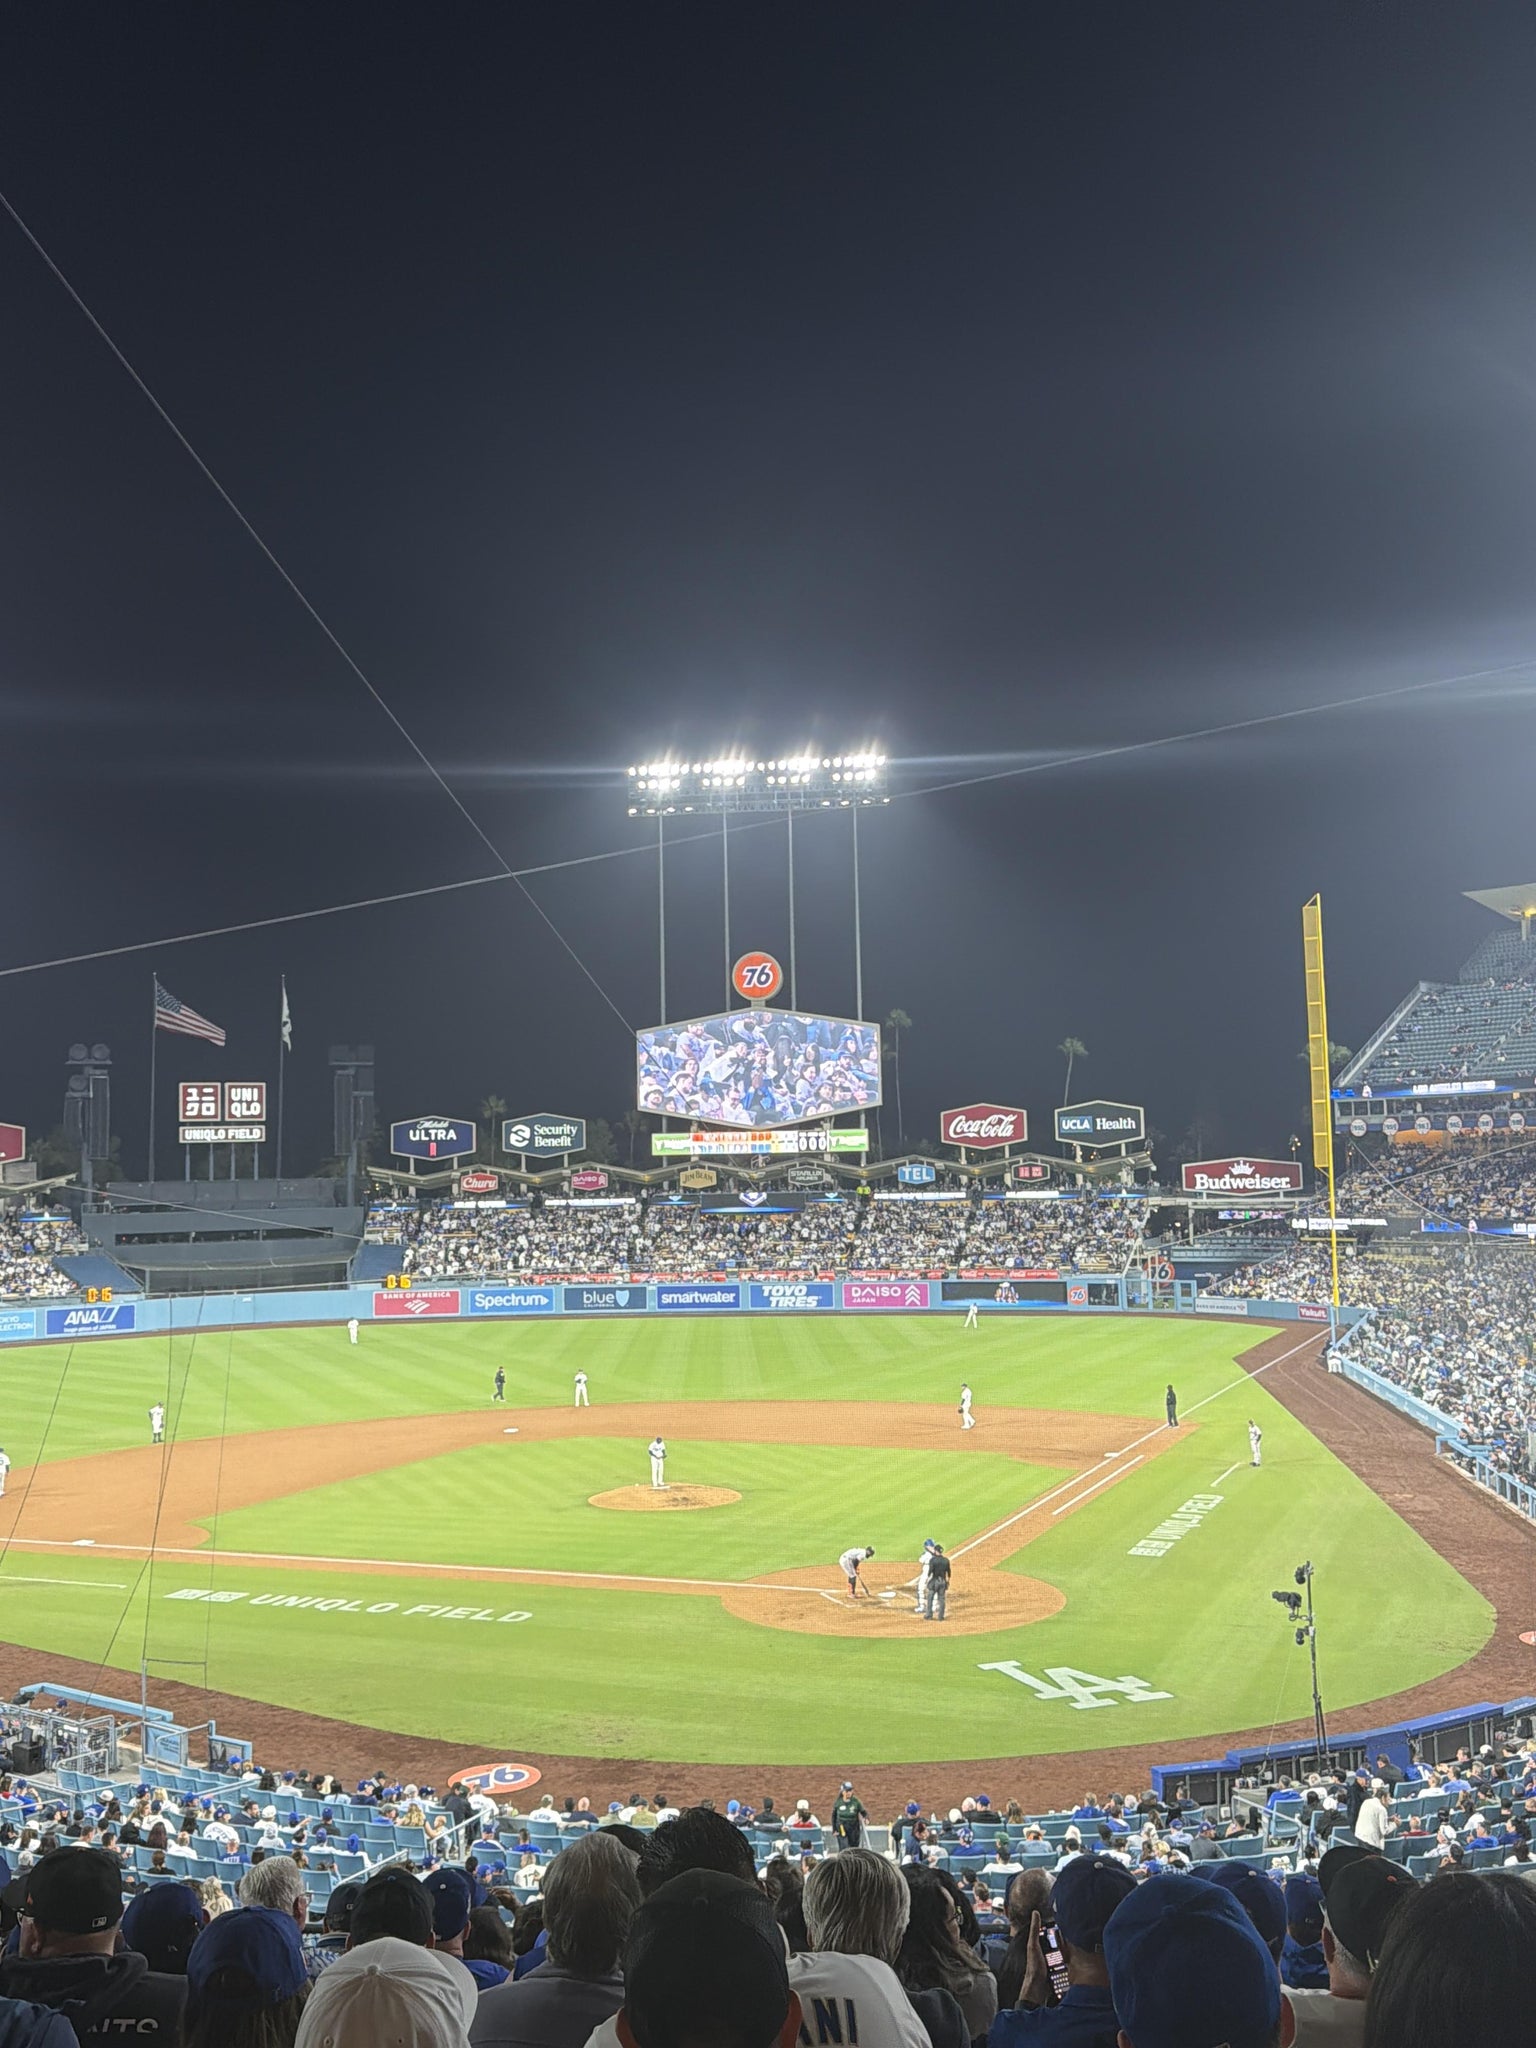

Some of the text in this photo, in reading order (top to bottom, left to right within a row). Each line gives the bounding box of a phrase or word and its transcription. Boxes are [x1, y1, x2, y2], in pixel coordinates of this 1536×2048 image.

[742, 963, 773, 988] 76
[230, 1087, 259, 1102] UNI
[230, 1102, 261, 1118] QLO
[533, 1123, 578, 1137] Security
[949, 1114, 1018, 1138] Coca-Cola
[1061, 1117, 1136, 1130] UCLA Health
[184, 1128, 261, 1141] UNIQLO FIELD
[409, 1129, 457, 1141] ULTRA
[534, 1135, 573, 1147] Benefit
[903, 1167, 931, 1180] TEL
[463, 1177, 496, 1189] Churu
[416, 1291, 451, 1299] AMERICA
[583, 1291, 615, 1304] blue
[661, 1290, 736, 1304] smartwater
[762, 1286, 807, 1297] TOYO
[851, 1286, 902, 1297] DAISO
[1071, 1288, 1084, 1301] 76
[475, 1292, 541, 1310] Spectrum
[770, 1296, 819, 1307] TIRES
[64, 1309, 99, 1325] ANA
[1300, 1308, 1327, 1318] Yakult
[1177, 1493, 1225, 1514] FIELD
[249, 1593, 400, 1613] UNIQLO
[402, 1603, 534, 1623] FIELD
[976, 1660, 1175, 1710] LA
[461, 1765, 530, 1791] 76
